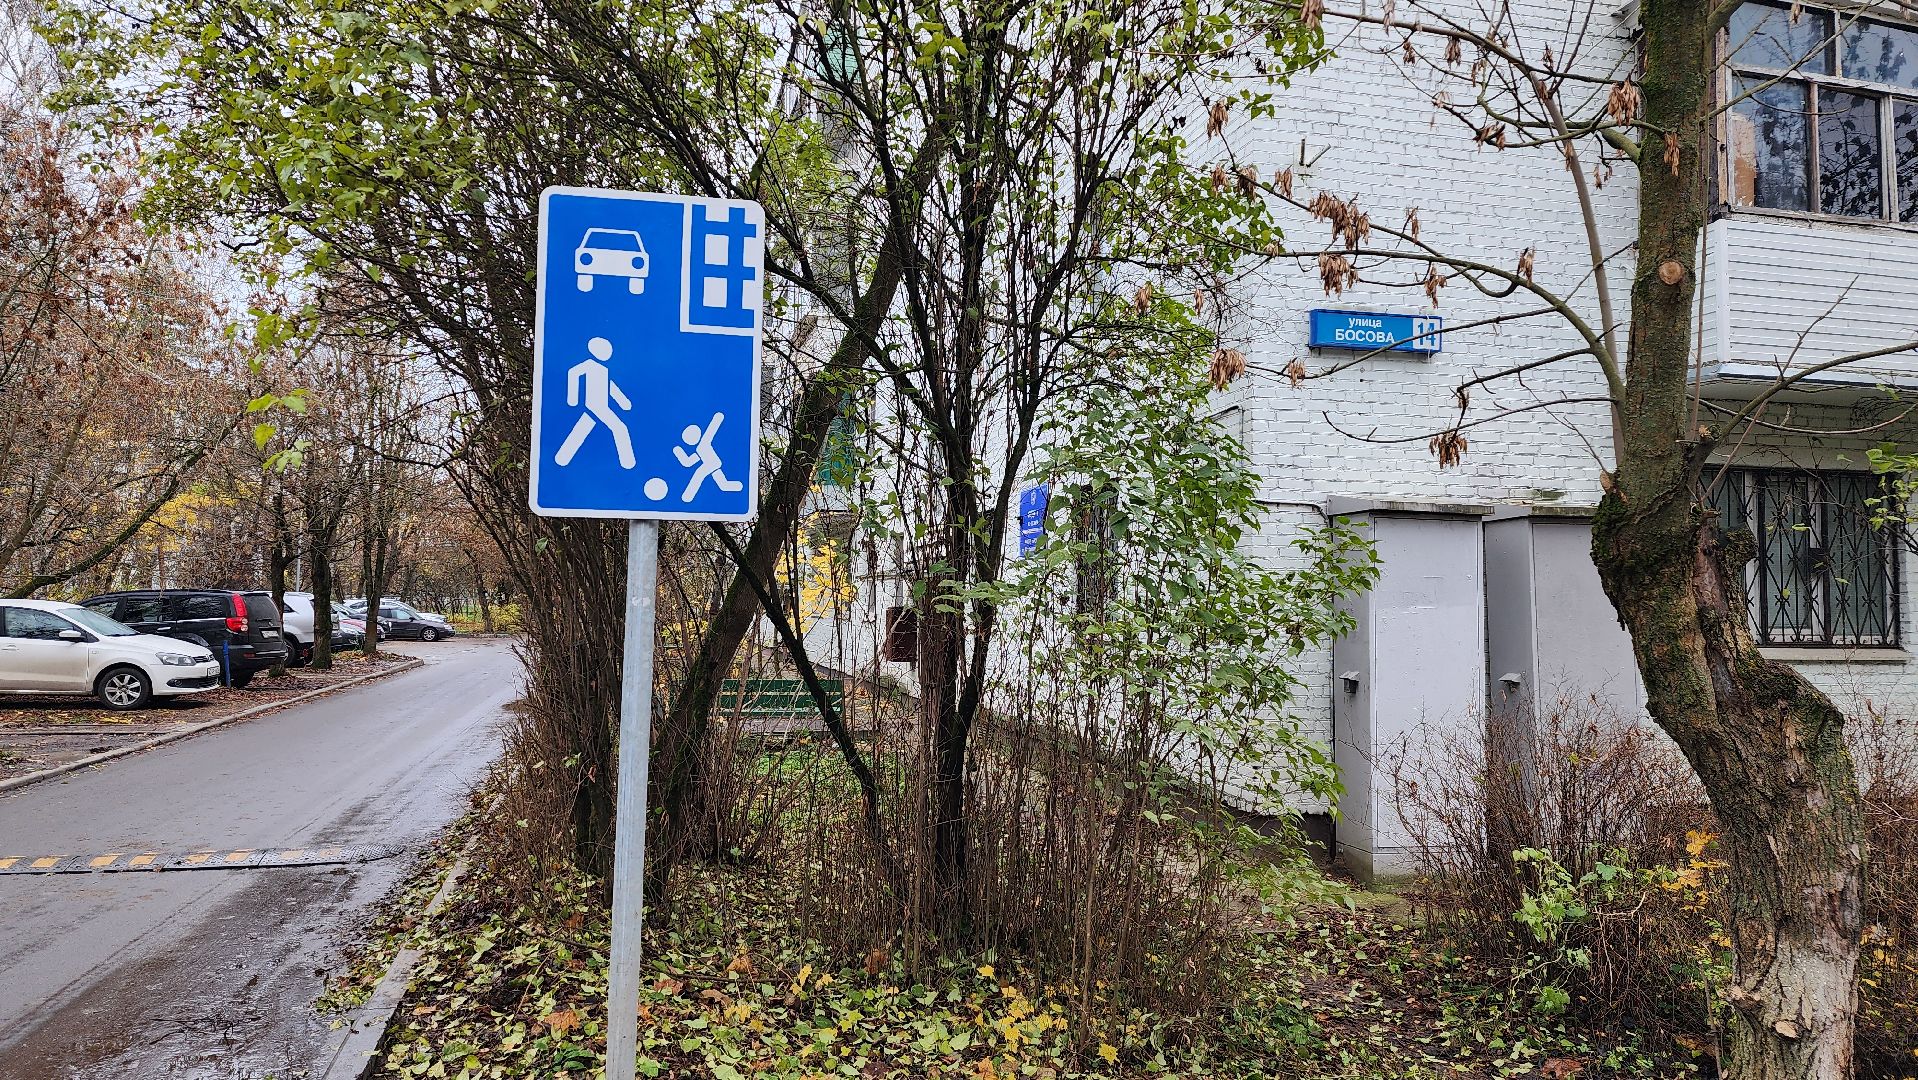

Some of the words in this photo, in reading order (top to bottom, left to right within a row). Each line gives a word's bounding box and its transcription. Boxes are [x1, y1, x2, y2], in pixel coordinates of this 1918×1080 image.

[1348, 317, 1382, 329] улица
[1335, 328, 1396, 344] БОСОВА
[1417, 321, 1436, 347] 14
